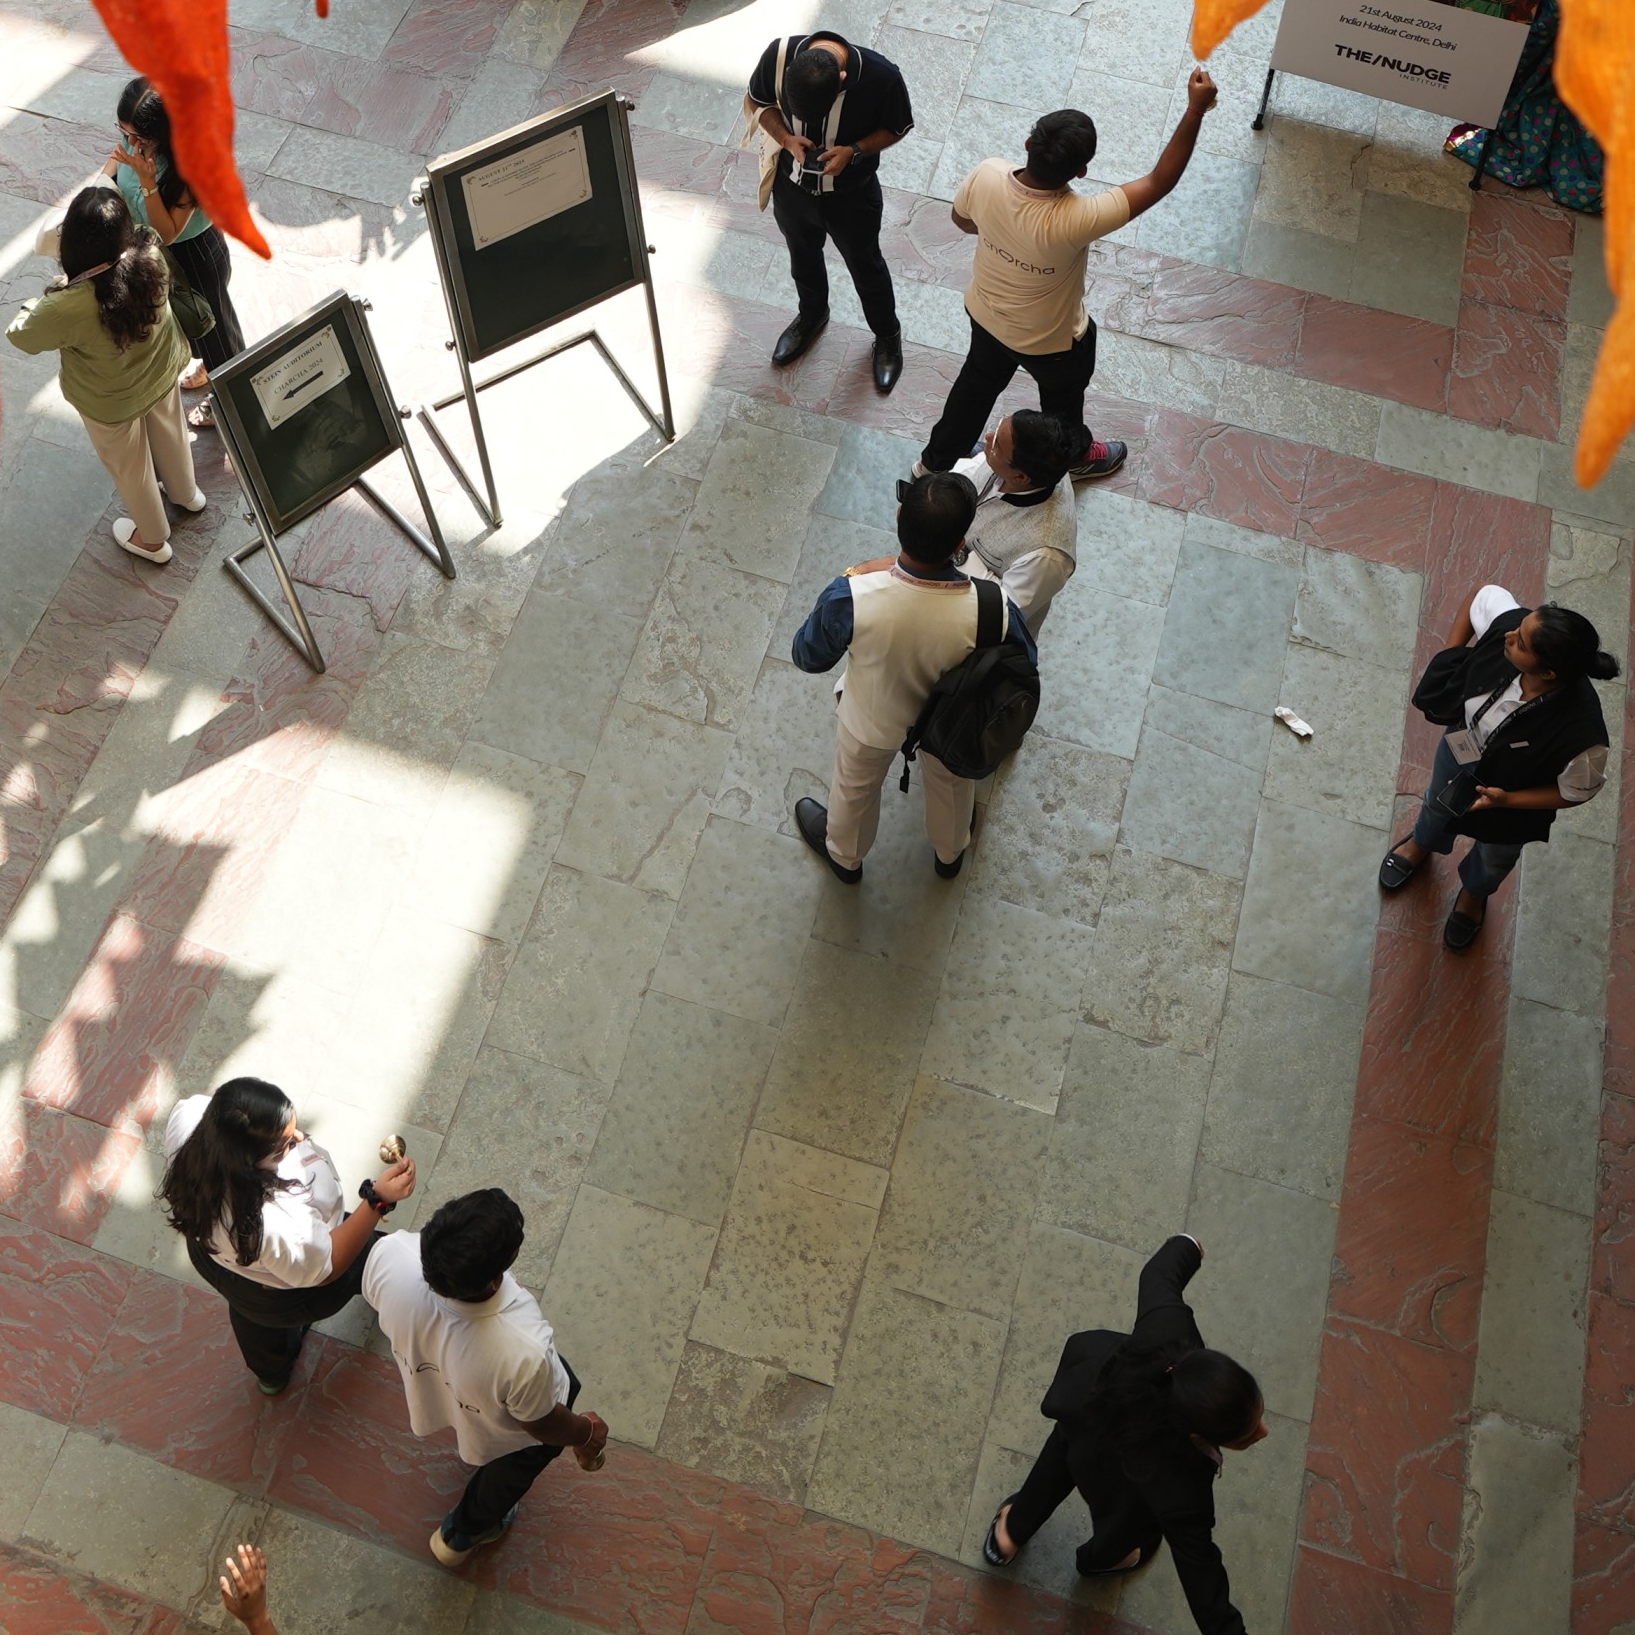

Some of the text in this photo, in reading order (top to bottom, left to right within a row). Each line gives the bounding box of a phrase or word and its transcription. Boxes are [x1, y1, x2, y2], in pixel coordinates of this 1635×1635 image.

[1339, 15, 1458, 52] India Habitat Centre, Delhi
[1359, 5, 1443, 32] 21st August 2024
[1335, 44, 1451, 84] THE/NUDGE
[1400, 73, 1448, 90] INSTITUTE
[263, 341, 323, 383] STEIN AUDITORIUM
[274, 357, 323, 394] CHARCHA 2024
